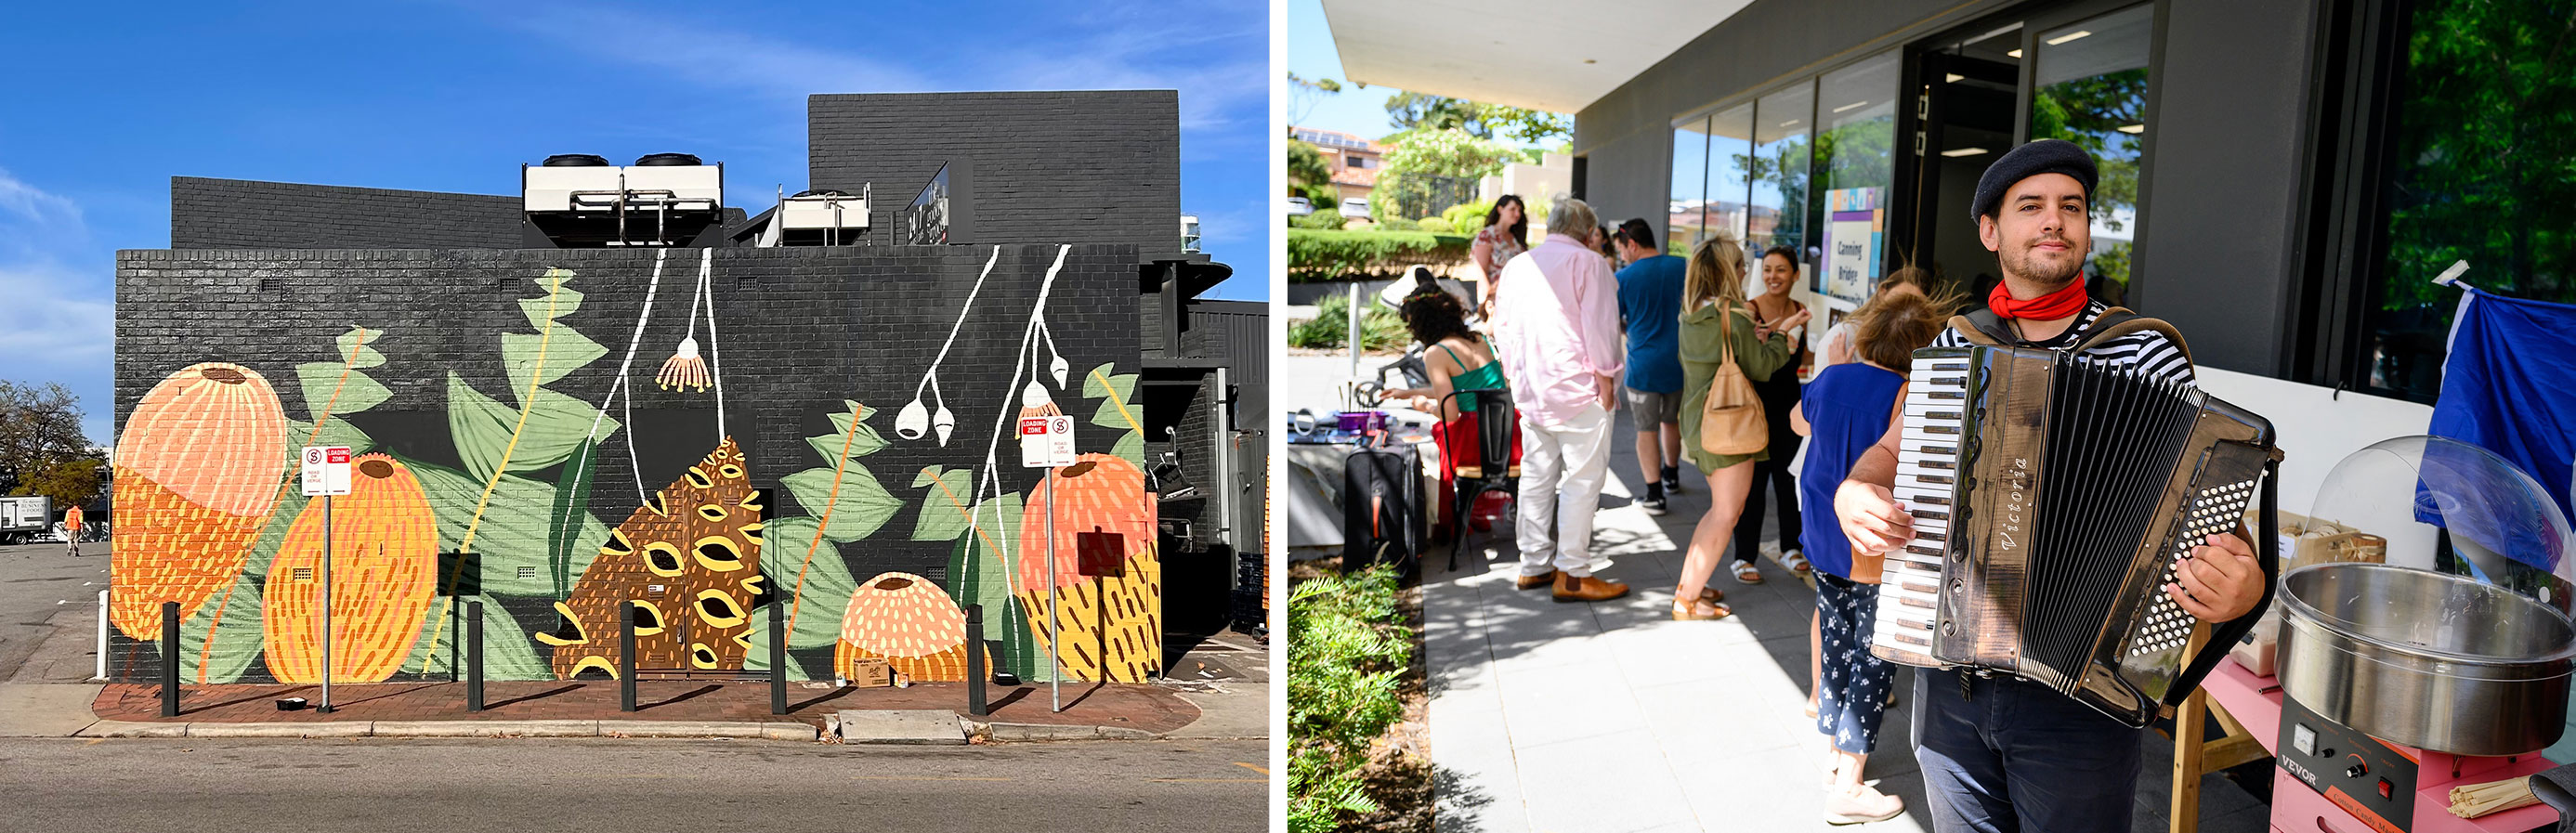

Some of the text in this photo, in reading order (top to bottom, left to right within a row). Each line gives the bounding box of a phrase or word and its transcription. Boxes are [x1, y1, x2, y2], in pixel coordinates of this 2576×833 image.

[1837, 241, 1863, 260] Canning
[1838, 266, 1858, 286] Bridge
[2000, 458, 2027, 551] Victoria
[2282, 754, 2317, 786] VEVOR
[2334, 793, 2354, 812] Cotton
[2356, 808, 2376, 826] Candy
